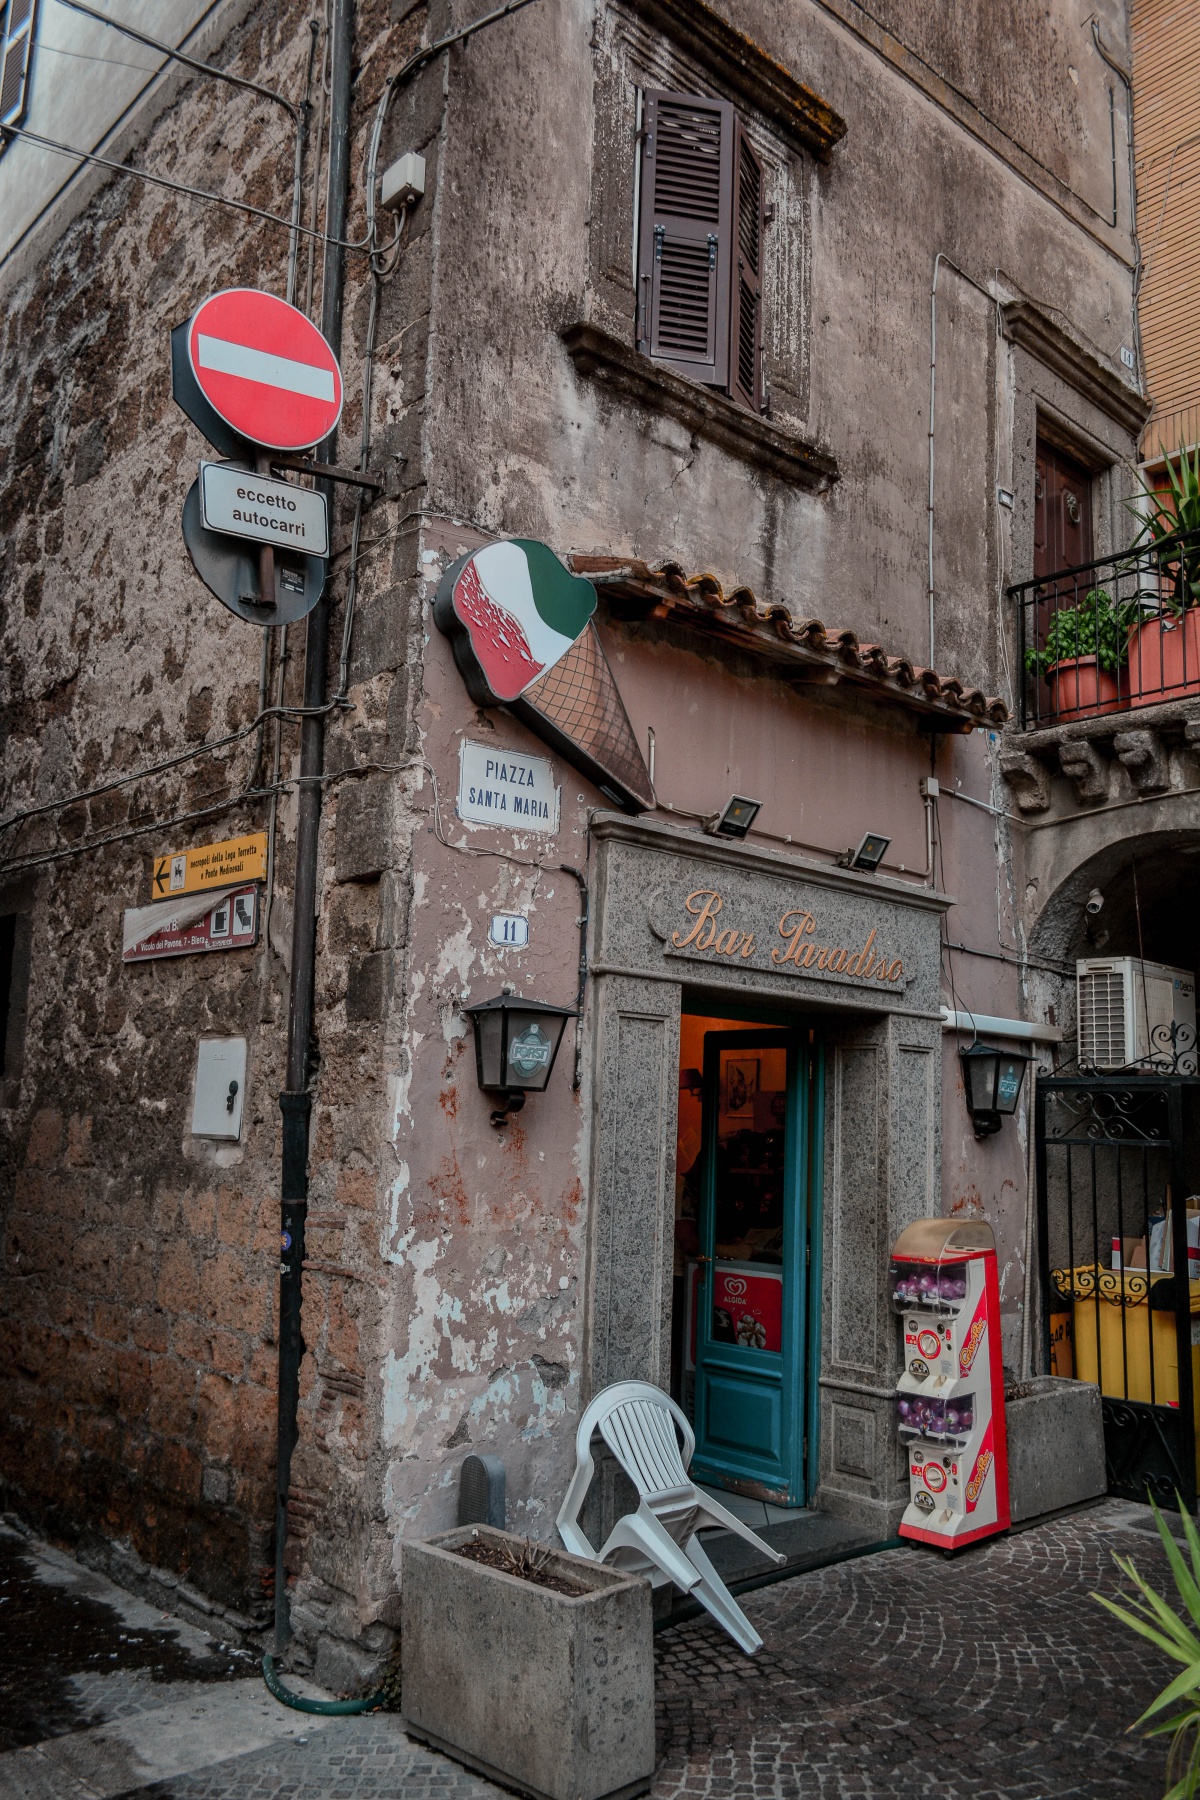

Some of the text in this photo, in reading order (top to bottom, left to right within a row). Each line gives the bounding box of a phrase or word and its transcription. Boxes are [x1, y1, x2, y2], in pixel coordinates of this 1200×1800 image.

[1123, 350, 1131, 365] 14
[236, 488, 297, 512] eccetto
[233, 509, 305, 537] autocarri
[485, 759, 535, 788] PIAZZA
[469, 787, 549, 819] SANTA MARIA
[190, 845, 257, 869] necropoli della Lega Torretta
[205, 868, 218, 879] Ponte
[219, 861, 244, 876] Medioevali
[502, 919, 517, 943] 11
[672, 889, 905, 983] Bar Paradiso
[140, 942, 156, 952] Vicolo
[156, 940, 164, 950] del
[514, 1045, 548, 1060] FORST
[723, 1296, 747, 1306] ALGIDA
